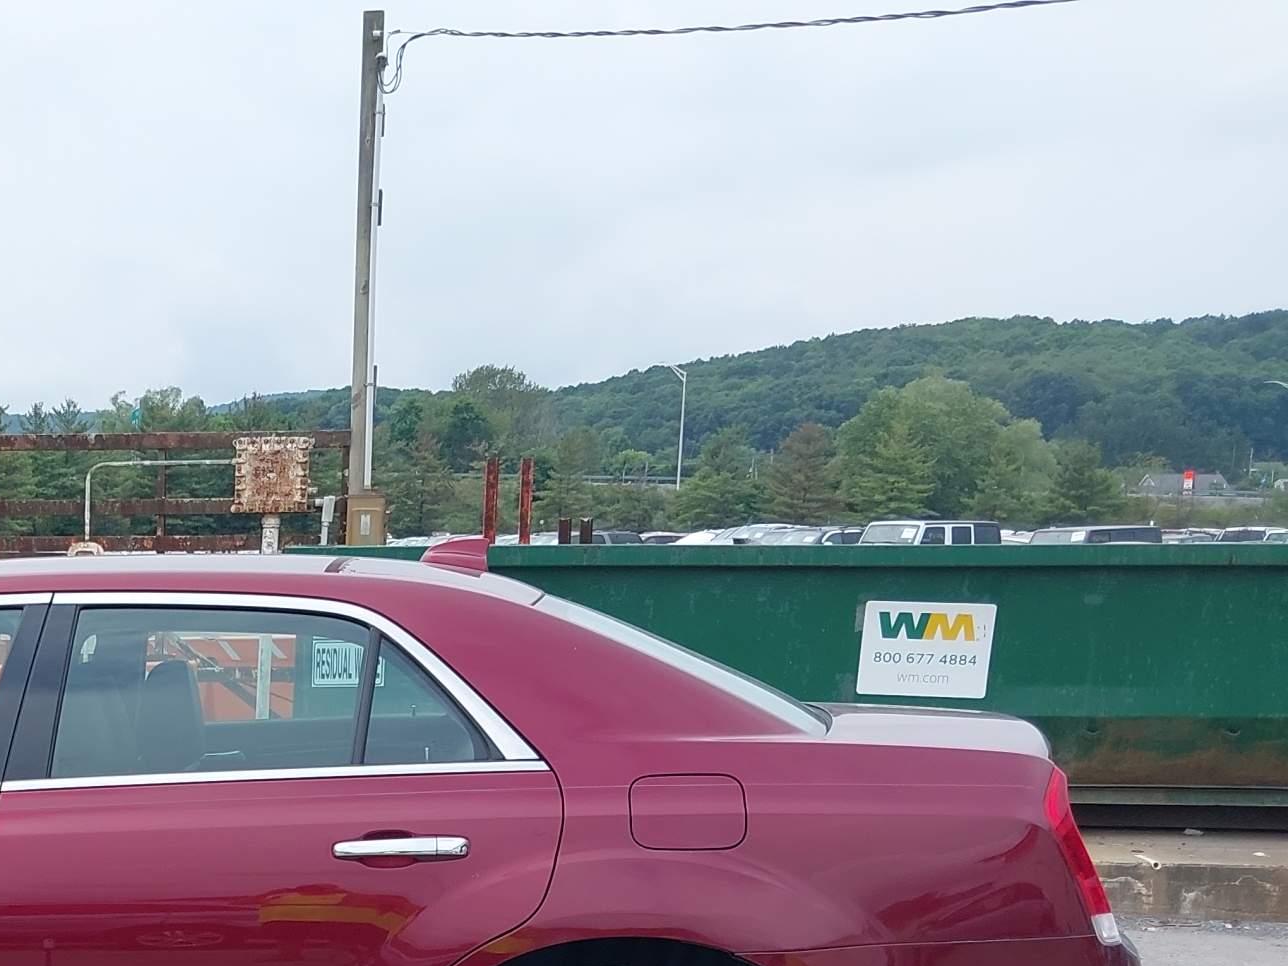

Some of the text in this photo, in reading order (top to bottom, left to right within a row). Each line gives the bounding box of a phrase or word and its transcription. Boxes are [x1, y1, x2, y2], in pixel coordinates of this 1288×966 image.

[316, 648, 353, 680] RESIDUAL
[873, 652, 977, 666] 800 677 4884
[897, 672, 949, 684] wm.com
